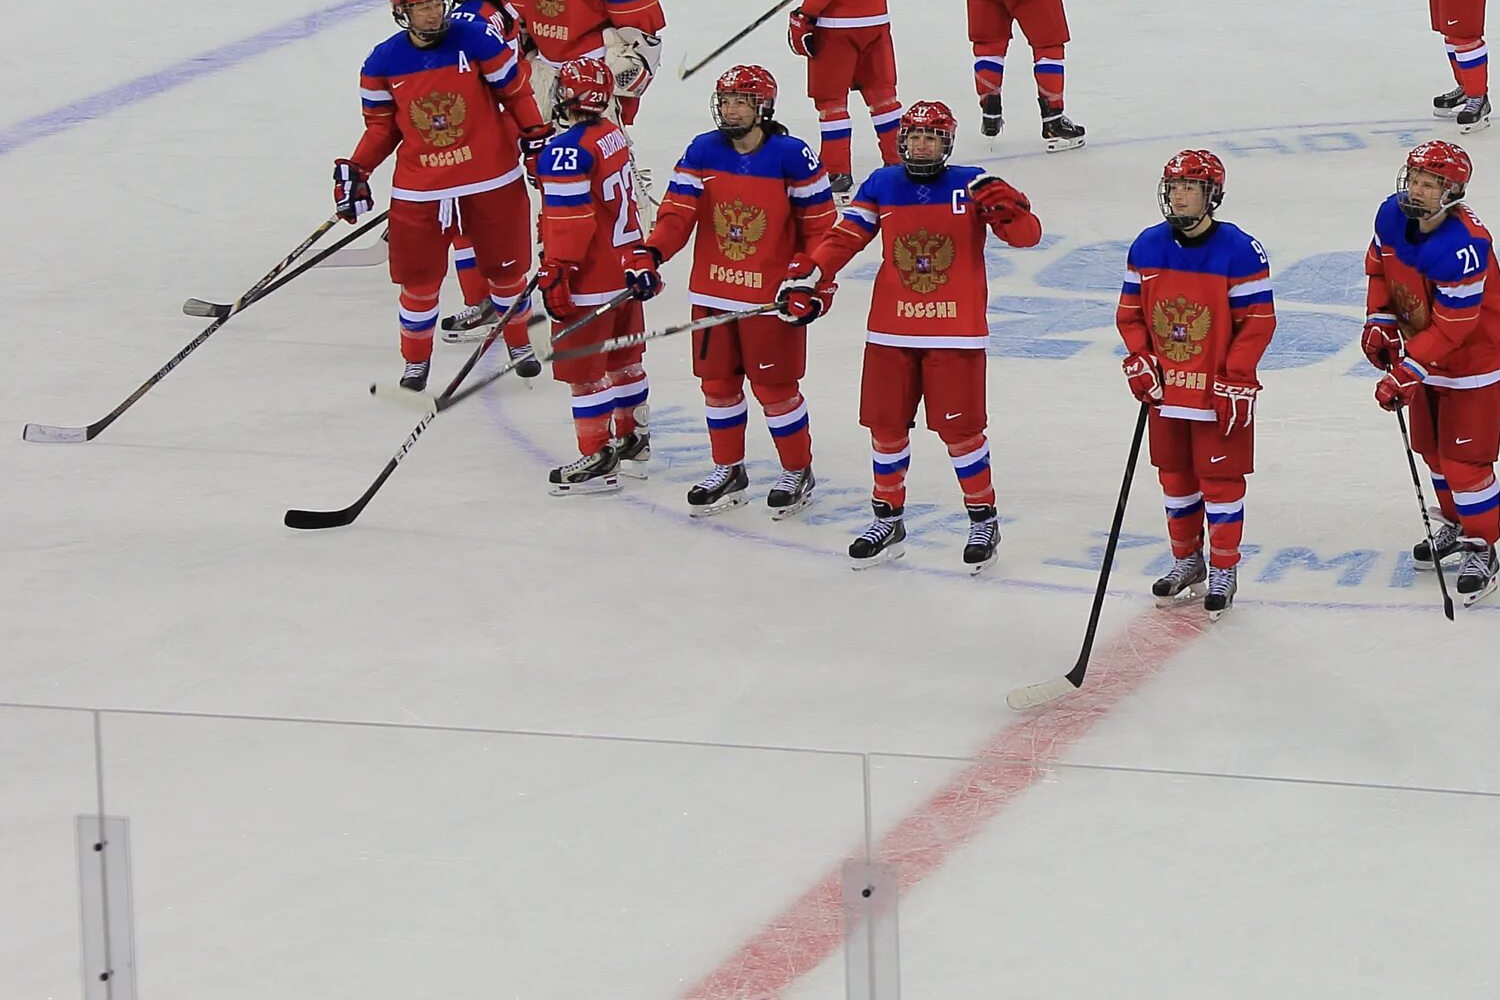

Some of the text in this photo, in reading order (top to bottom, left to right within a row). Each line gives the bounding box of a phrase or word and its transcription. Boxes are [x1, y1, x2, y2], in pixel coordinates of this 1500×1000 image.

[458, 51, 471, 73] A
[590, 92, 603, 102] 23
[420, 145, 472, 167] РОССИЯ
[551, 147, 578, 171] 23
[952, 189, 966, 214] C
[1456, 245, 1480, 274] 21
[709, 264, 763, 289] РОССИЯ
[897, 300, 957, 318] РОССИЯ
[1213, 382, 1257, 396] CCM
